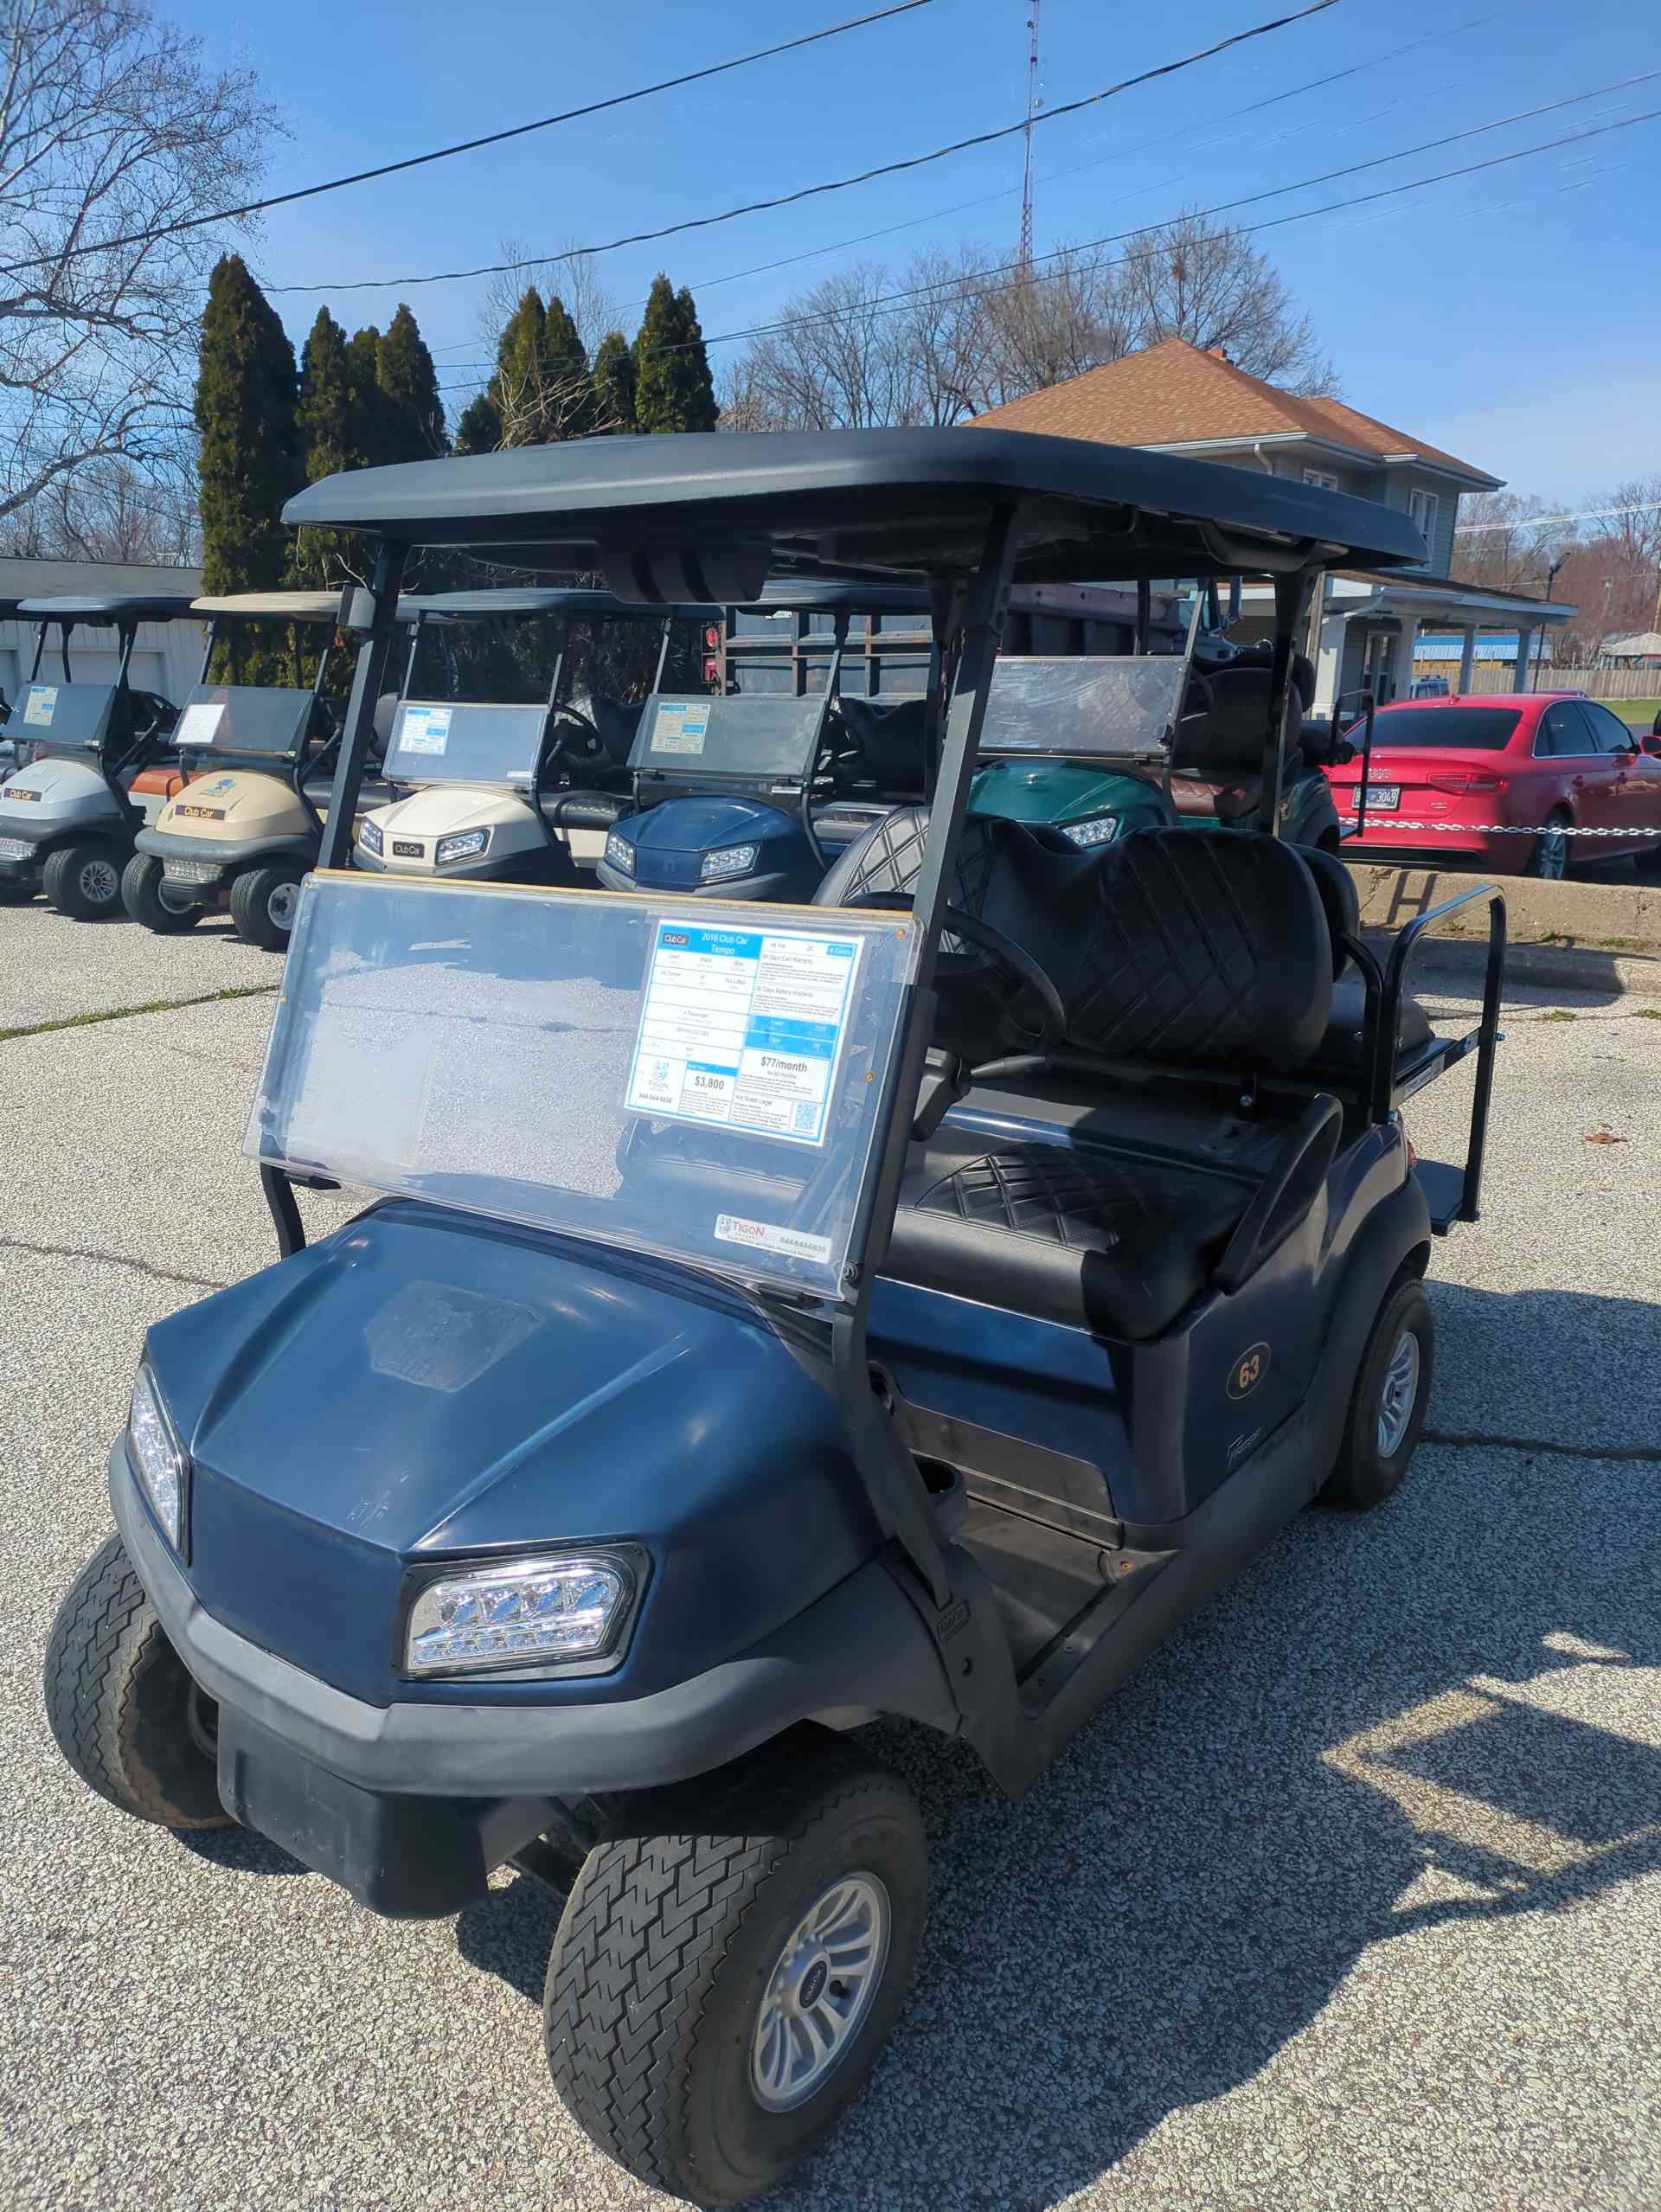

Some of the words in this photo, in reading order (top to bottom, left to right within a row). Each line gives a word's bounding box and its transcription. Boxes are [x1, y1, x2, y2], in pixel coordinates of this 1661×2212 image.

[185, 806, 199, 817] Club
[201, 809, 214, 817] Car
[719, 934, 734, 943] Club
[735, 936, 747, 945] Car
[711, 944, 735, 955] Tempo
[761, 1056, 808, 1073] $77/month
[695, 1075, 724, 1090] $3,800
[733, 1221, 765, 1237] TIGON
[1239, 1355, 1260, 1388] 63
